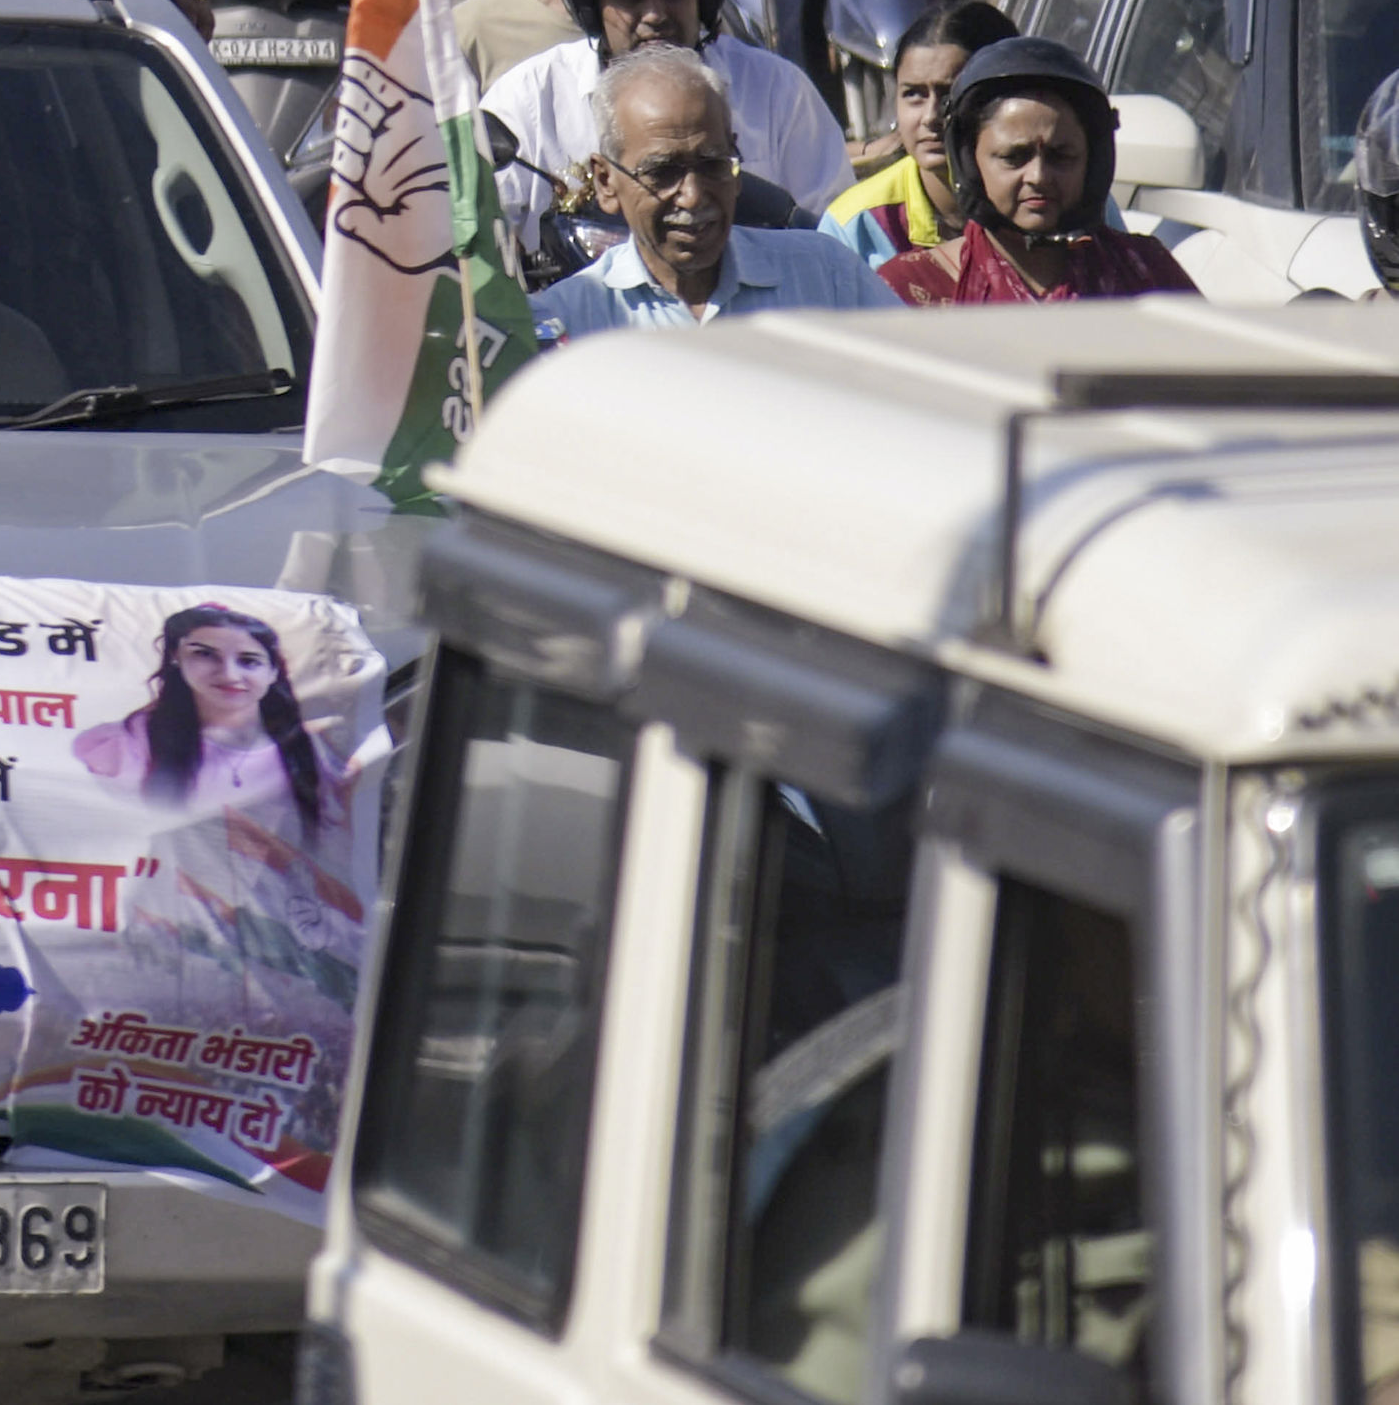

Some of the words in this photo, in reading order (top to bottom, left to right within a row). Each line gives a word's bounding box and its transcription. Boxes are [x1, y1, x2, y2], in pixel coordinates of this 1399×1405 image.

[203, 40, 337, 59] K-07FH-2204
[46, 618, 104, 661] में
[71, 1011, 198, 1063] अंकिता
[200, 1028, 317, 1085] भंडारी
[77, 1066, 131, 1114] को
[135, 1081, 236, 1135] न्याय
[239, 1093, 284, 1144] दो
